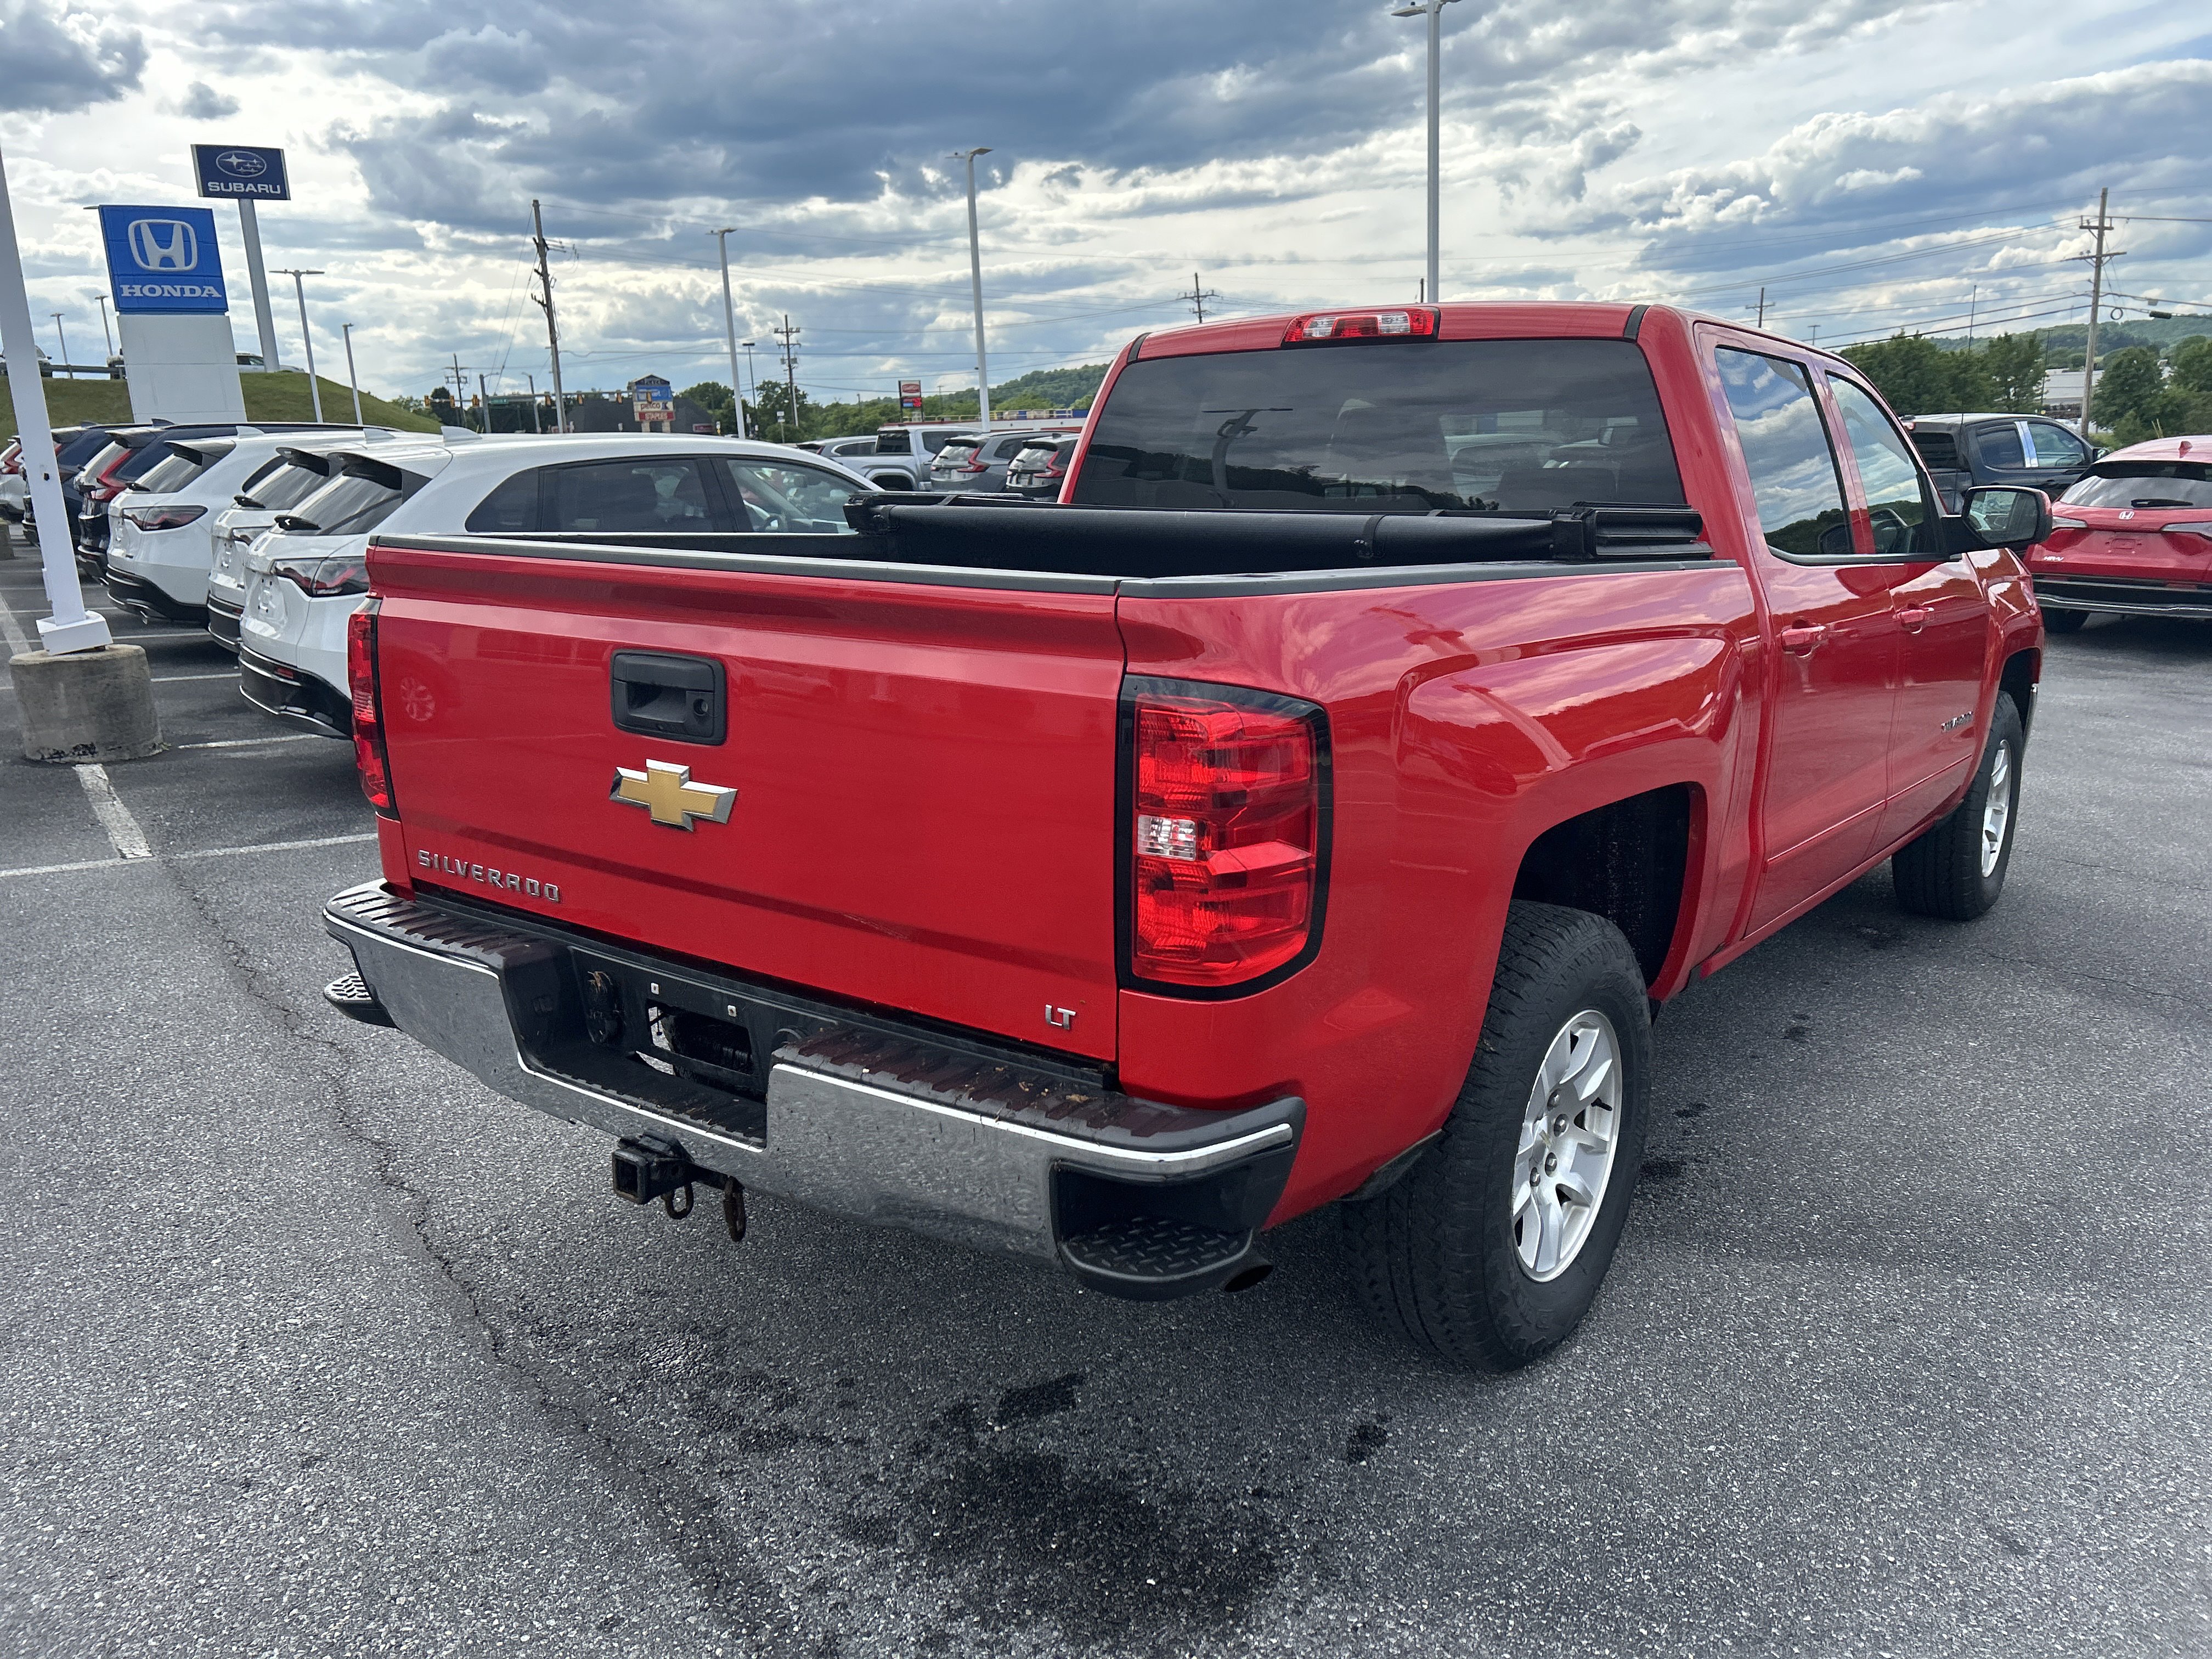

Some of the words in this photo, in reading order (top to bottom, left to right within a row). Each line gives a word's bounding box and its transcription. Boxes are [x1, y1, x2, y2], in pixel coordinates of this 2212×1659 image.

[208, 182, 280, 194] SUBARU
[120, 284, 222, 297] HONDA
[418, 849, 560, 902] SILVERADO
[1045, 1004, 1076, 1030] LT
